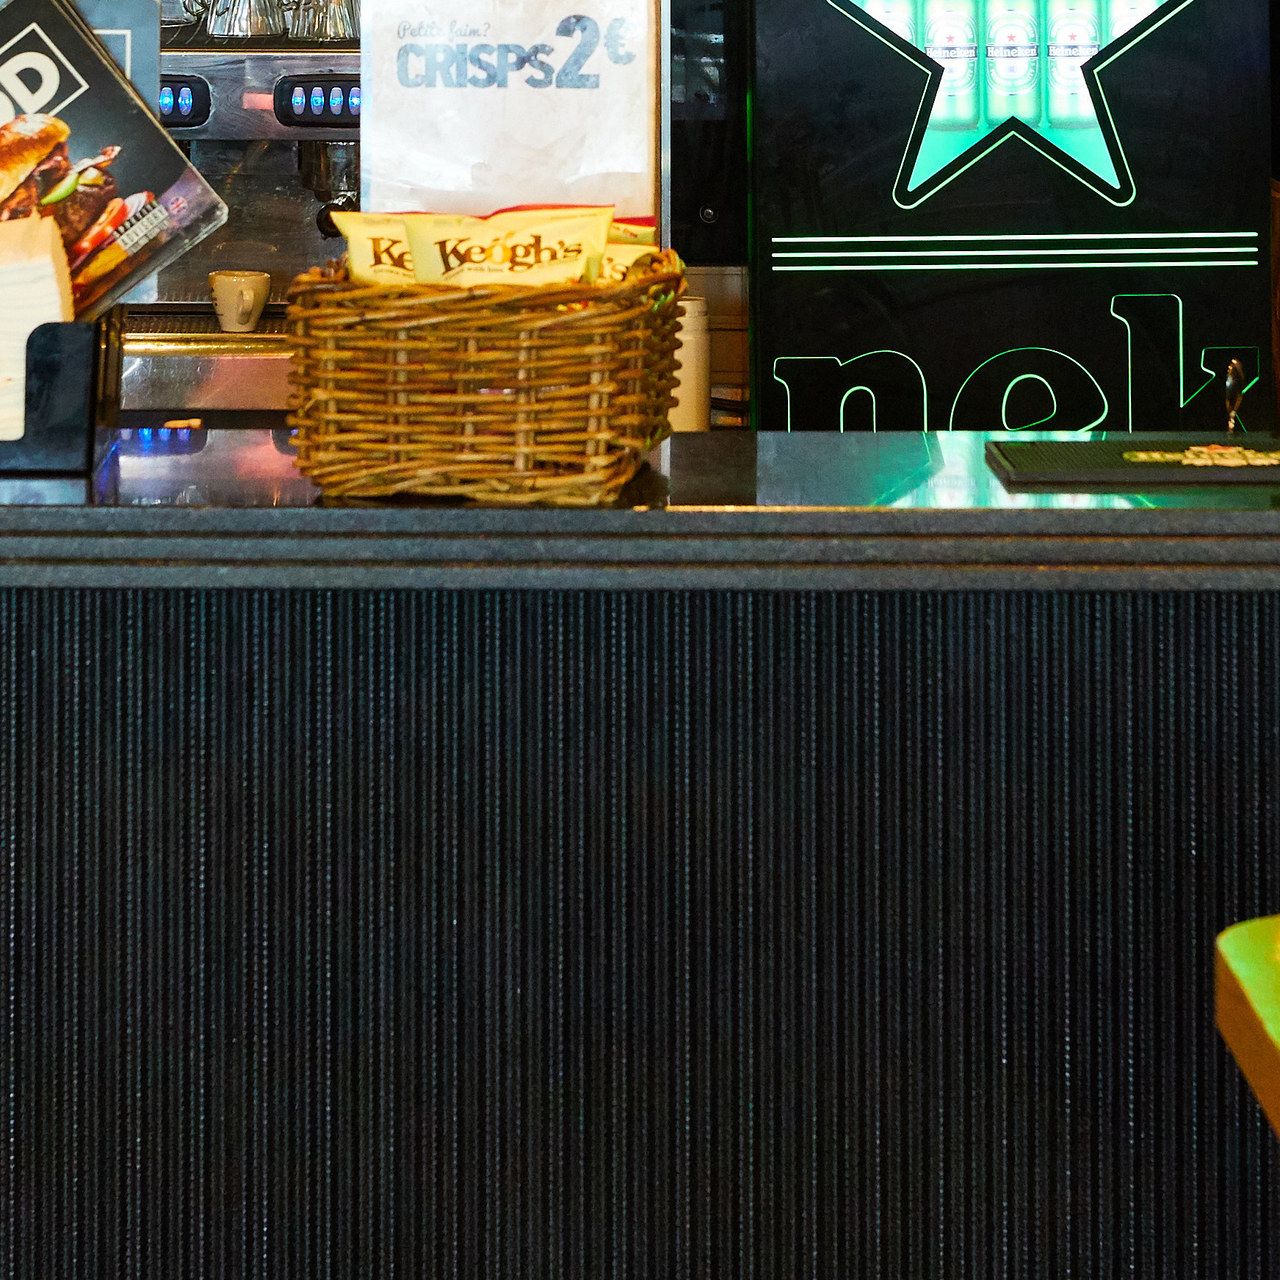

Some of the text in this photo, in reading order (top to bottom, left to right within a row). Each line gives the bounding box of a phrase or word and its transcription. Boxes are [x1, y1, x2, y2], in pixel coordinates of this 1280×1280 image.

[925, 46, 976, 58] Heineken
[987, 46, 1038, 57] Heineken
[1049, 45, 1099, 56] Heineken
[397, 43, 555, 89] CRISPS
